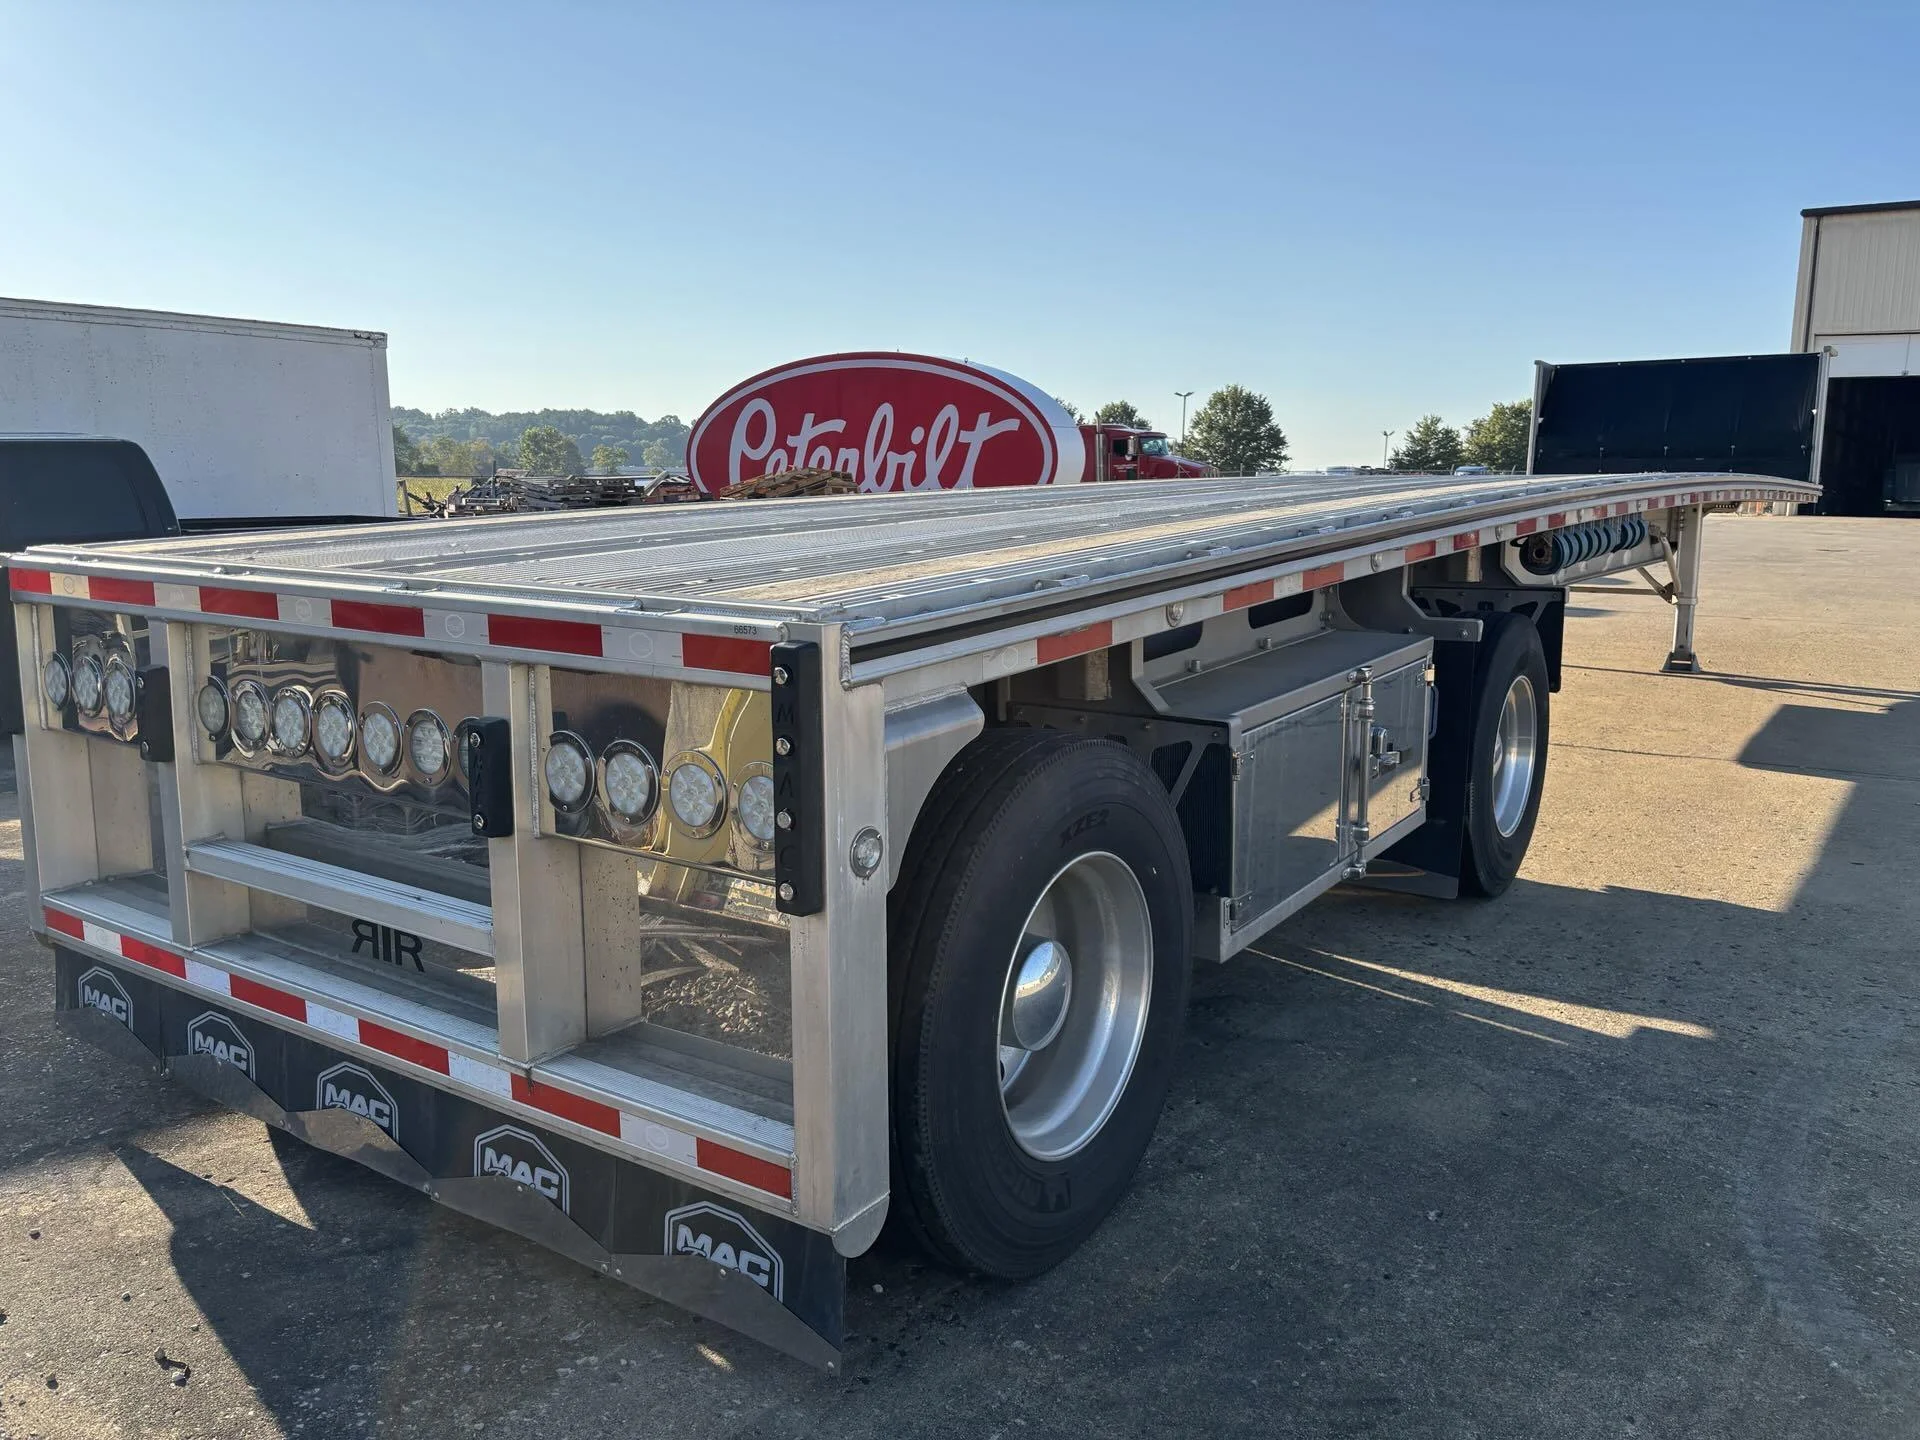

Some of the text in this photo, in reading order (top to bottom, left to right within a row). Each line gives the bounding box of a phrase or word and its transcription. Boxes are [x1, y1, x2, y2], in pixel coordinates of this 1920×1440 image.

[728, 397, 1021, 491] Peterbilt
[83, 984, 127, 1021] MAC
[194, 1030, 248, 1071] MAC
[324, 1082, 390, 1128] MAC
[484, 1146, 559, 1200] MAC
[675, 1223, 771, 1287] MAC
